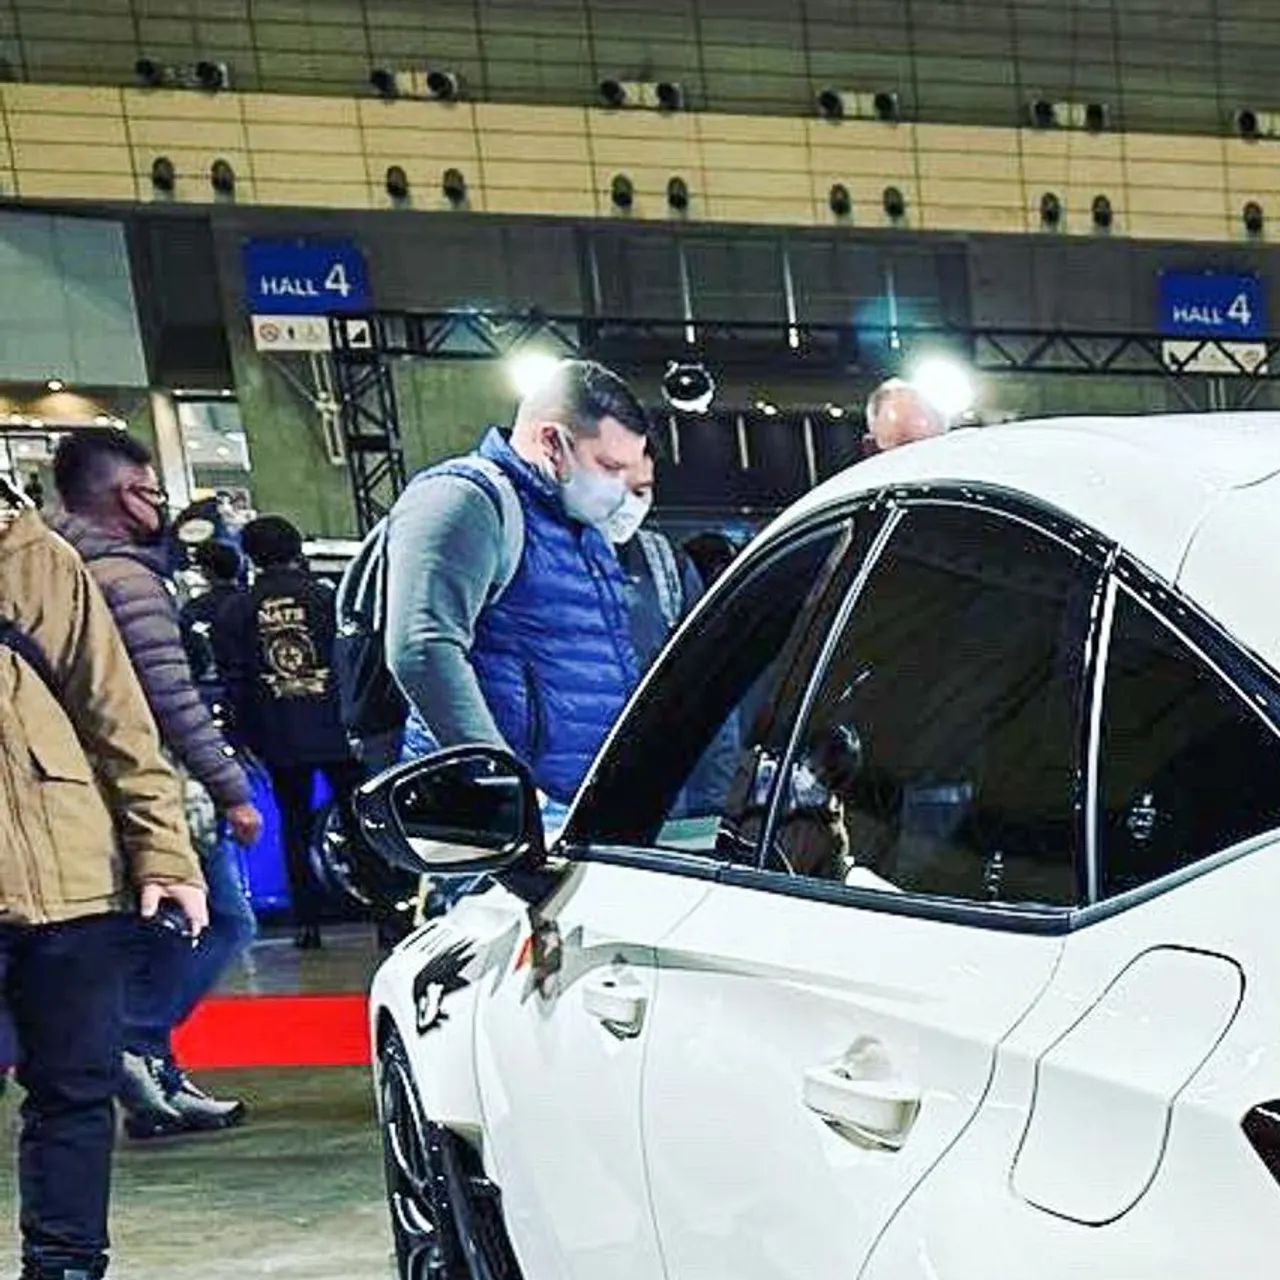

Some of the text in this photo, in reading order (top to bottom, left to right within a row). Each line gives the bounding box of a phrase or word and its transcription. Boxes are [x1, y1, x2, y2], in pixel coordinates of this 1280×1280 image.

[260, 262, 352, 298] HALL 4
[1172, 292, 1252, 326] HALL 4
